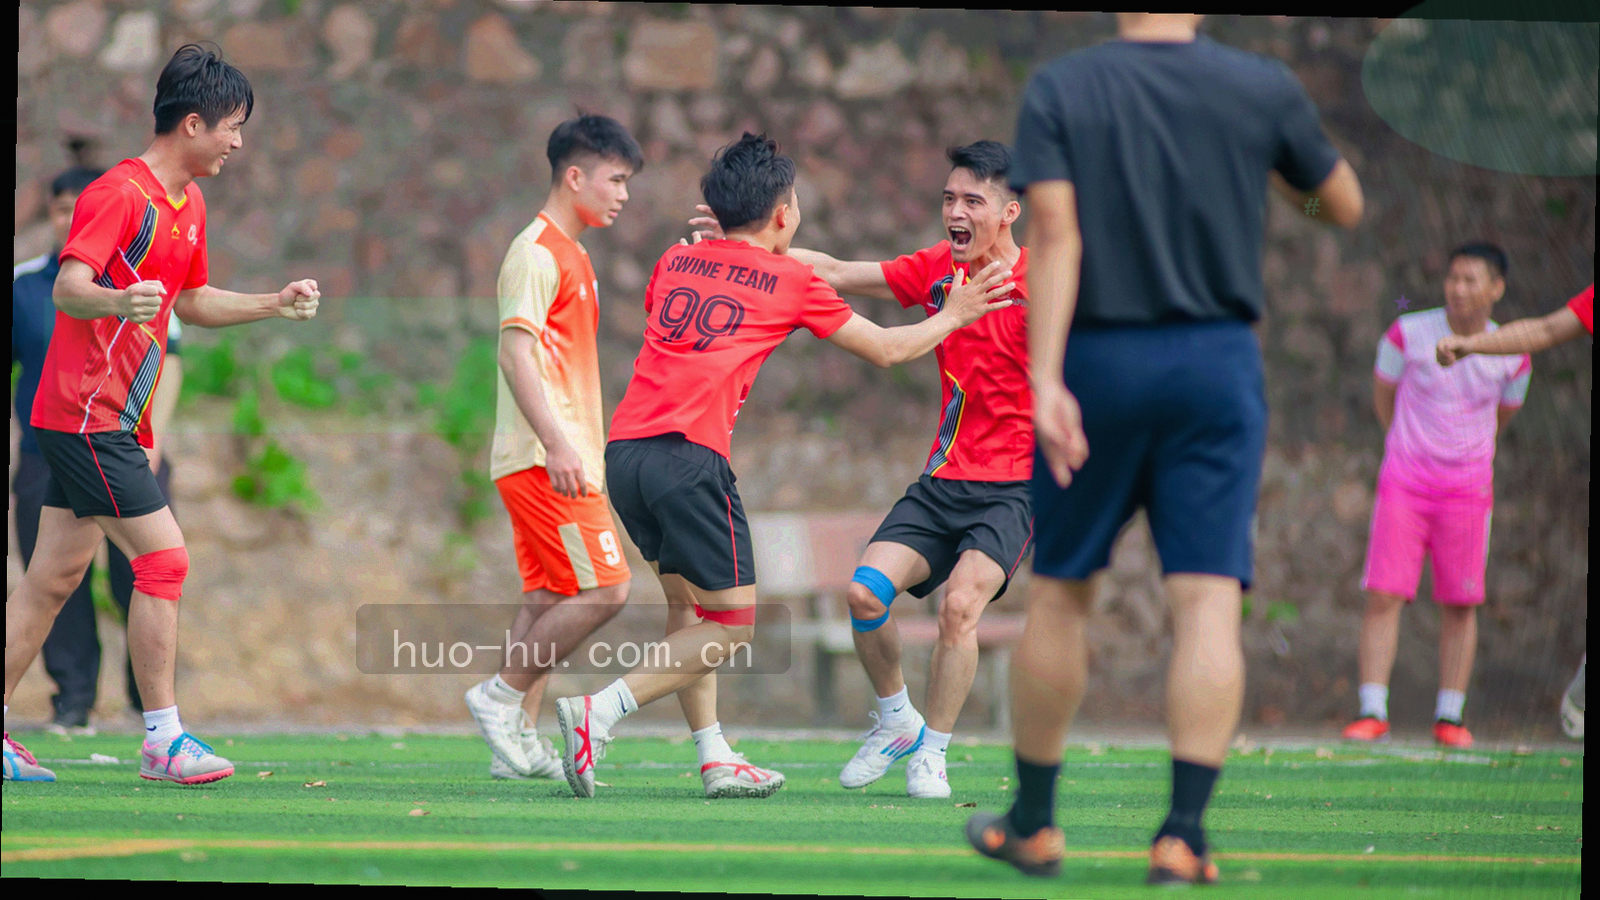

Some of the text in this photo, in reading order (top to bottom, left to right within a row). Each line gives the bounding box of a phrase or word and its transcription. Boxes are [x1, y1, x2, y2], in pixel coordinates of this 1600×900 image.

[667, 255, 779, 295] SWINE TEAM
[658, 286, 745, 351] 99
[598, 530, 620, 566] 9
